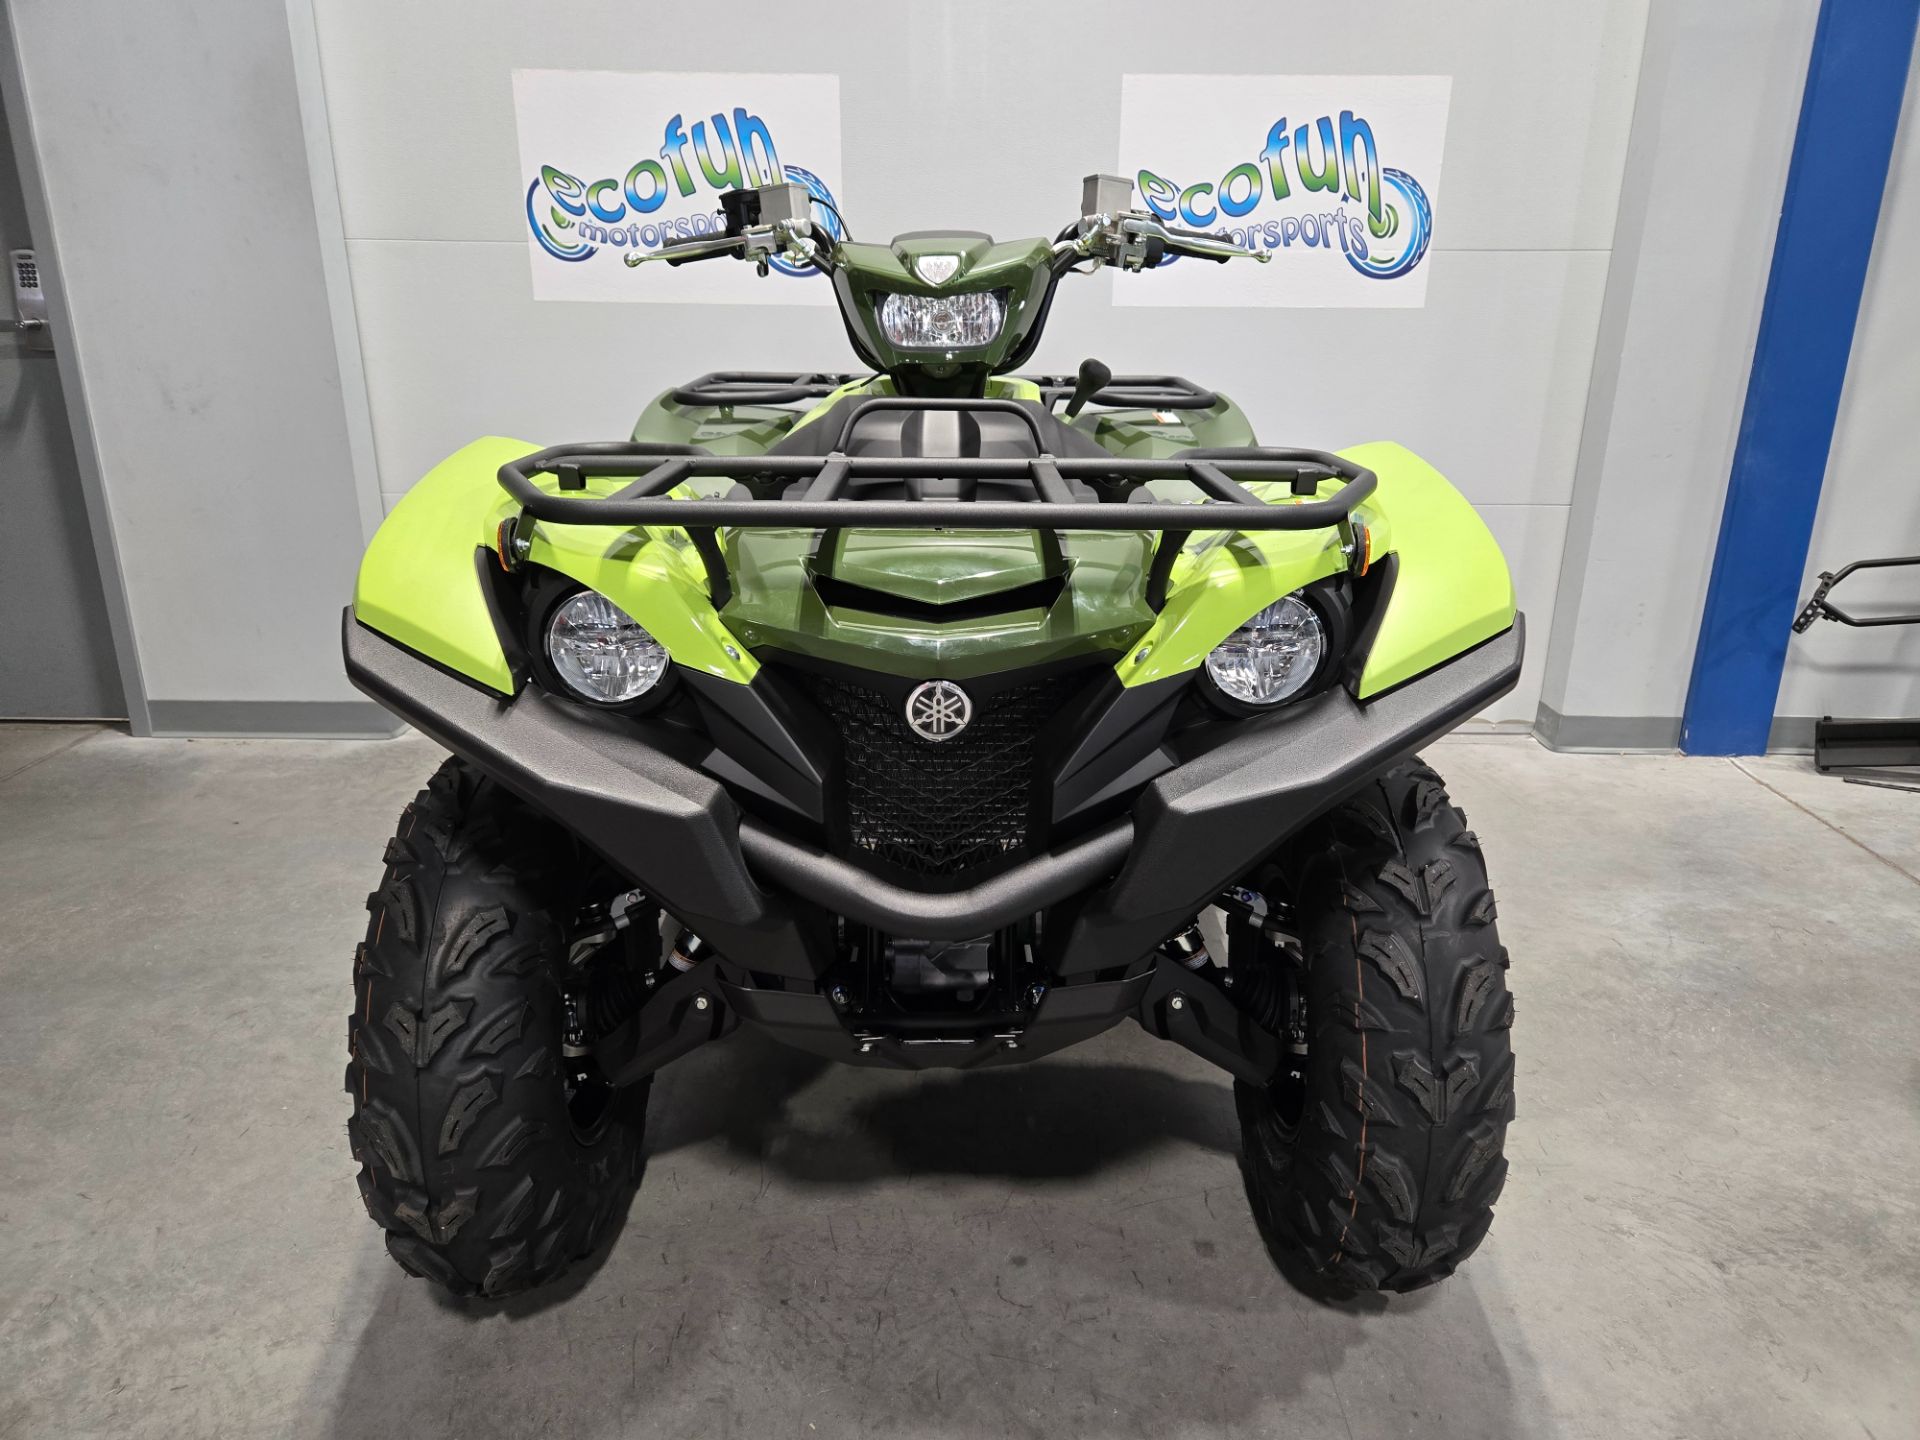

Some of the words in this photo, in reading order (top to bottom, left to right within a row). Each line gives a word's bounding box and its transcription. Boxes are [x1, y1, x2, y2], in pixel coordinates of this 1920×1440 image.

[1138, 110, 1382, 227] ecofun
[578, 213, 727, 248] motorspo
[1217, 207, 1368, 260] orsports
